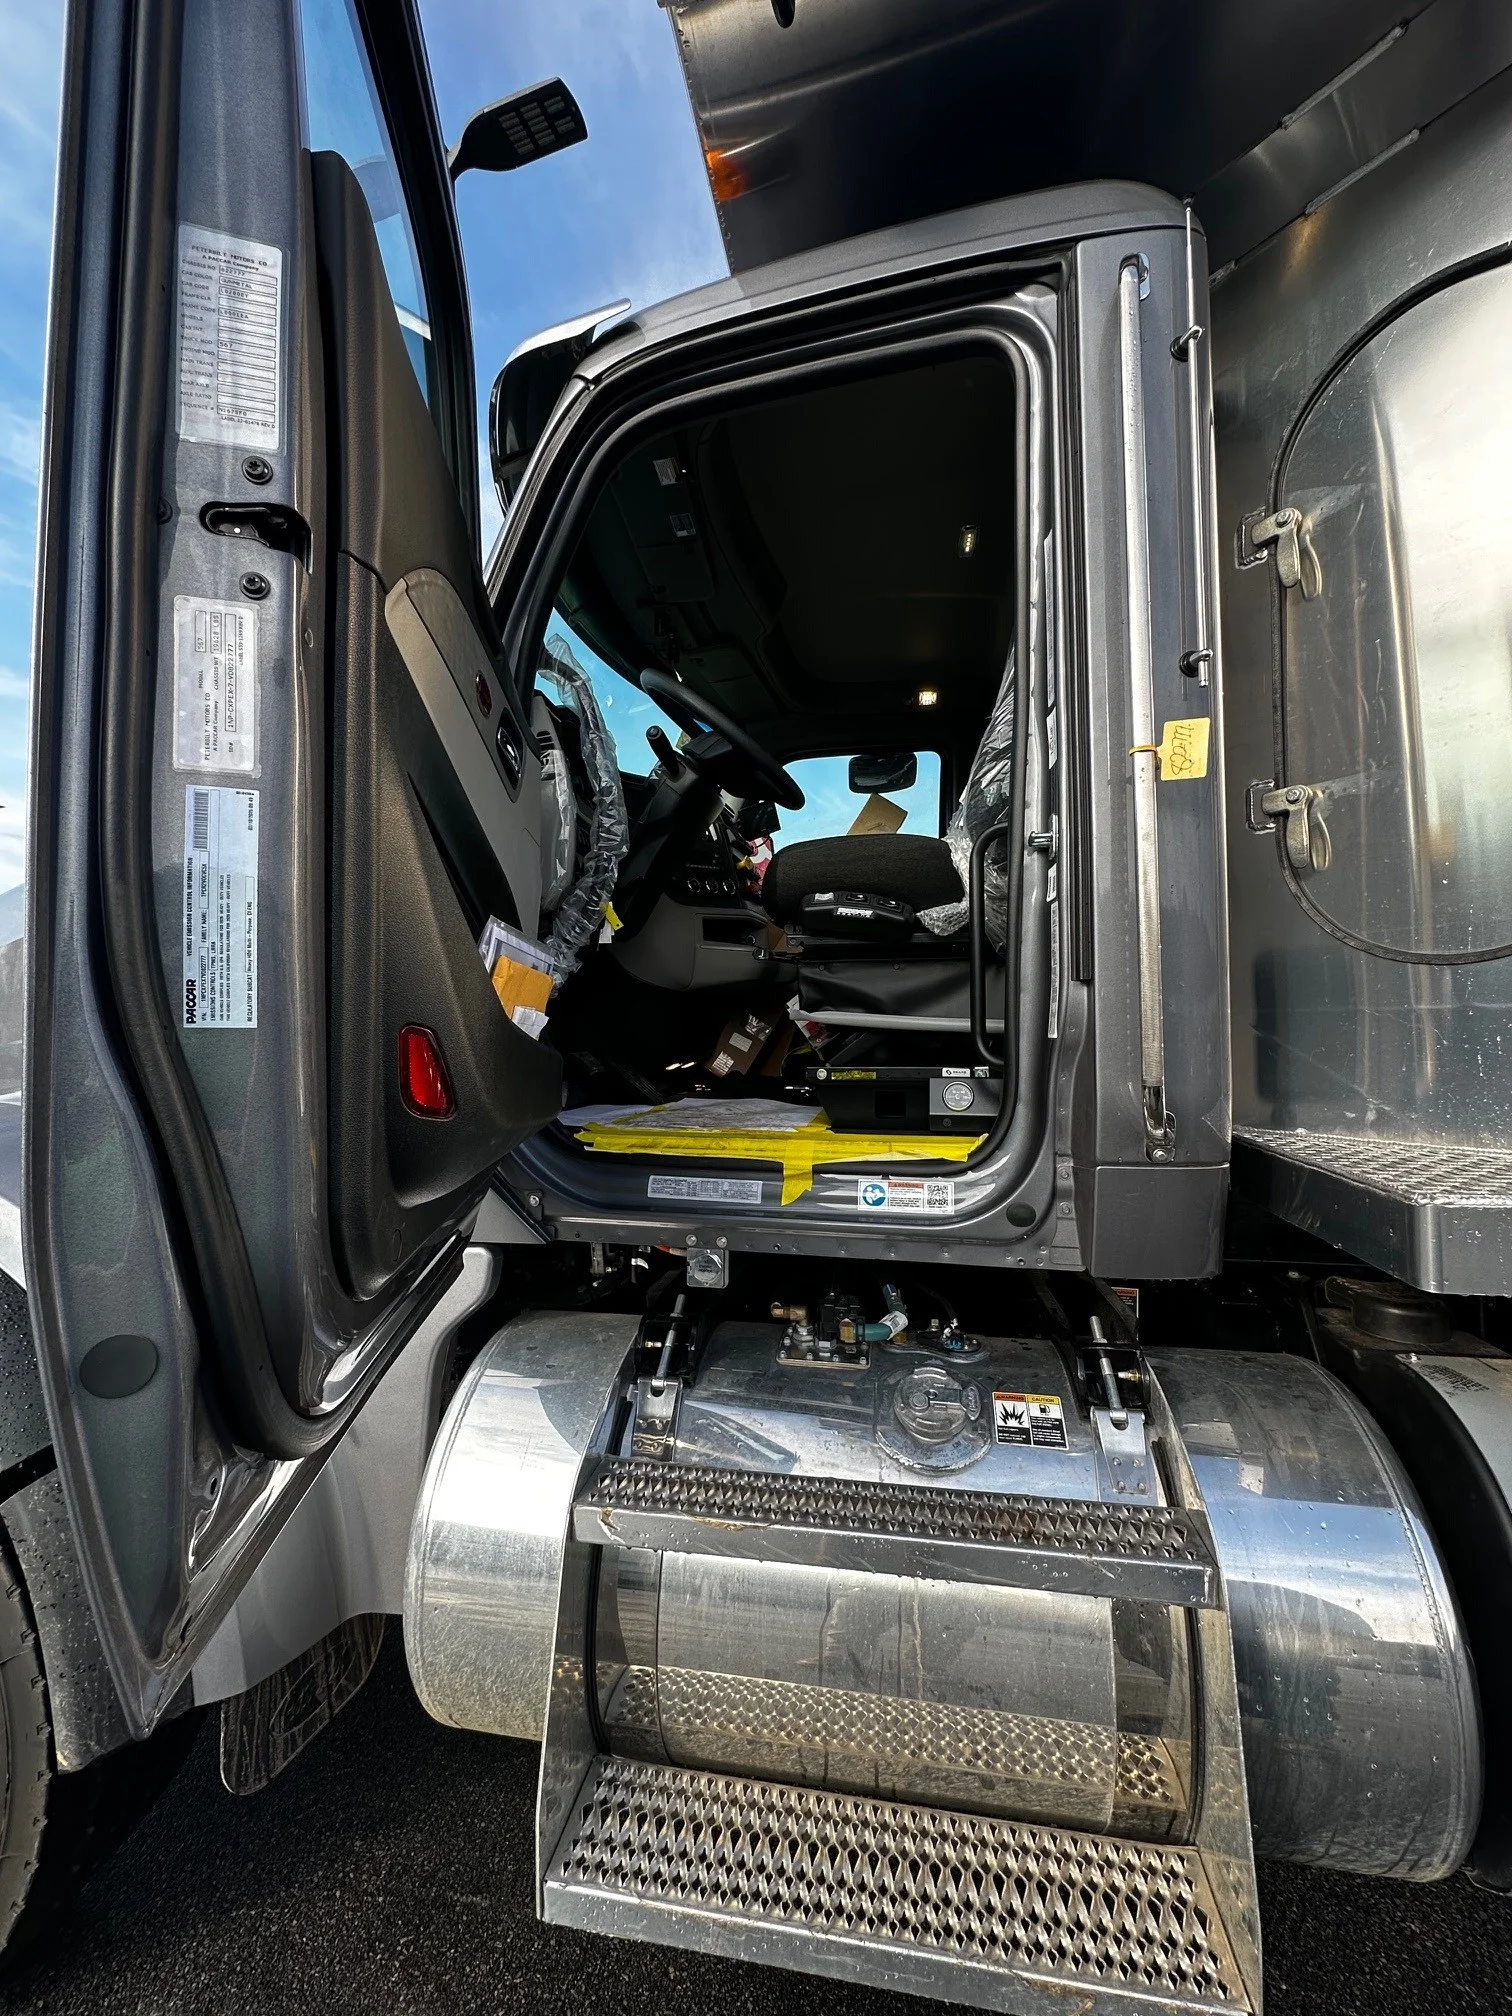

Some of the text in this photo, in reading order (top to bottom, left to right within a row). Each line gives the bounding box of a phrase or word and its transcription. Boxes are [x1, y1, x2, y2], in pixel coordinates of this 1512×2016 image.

[192, 245, 226, 256] PETERBILT
[231, 254, 254, 263] MOTORS
[182, 260, 206, 268] CHASSIS
[208, 256, 232, 264] PACCAR
[233, 261, 259, 271] Company
[180, 402, 208, 410] SEQUENCE
[214, 657, 218, 665] WT
[205, 693, 210, 701] CO
[186, 979, 196, 1024] PACCAR
